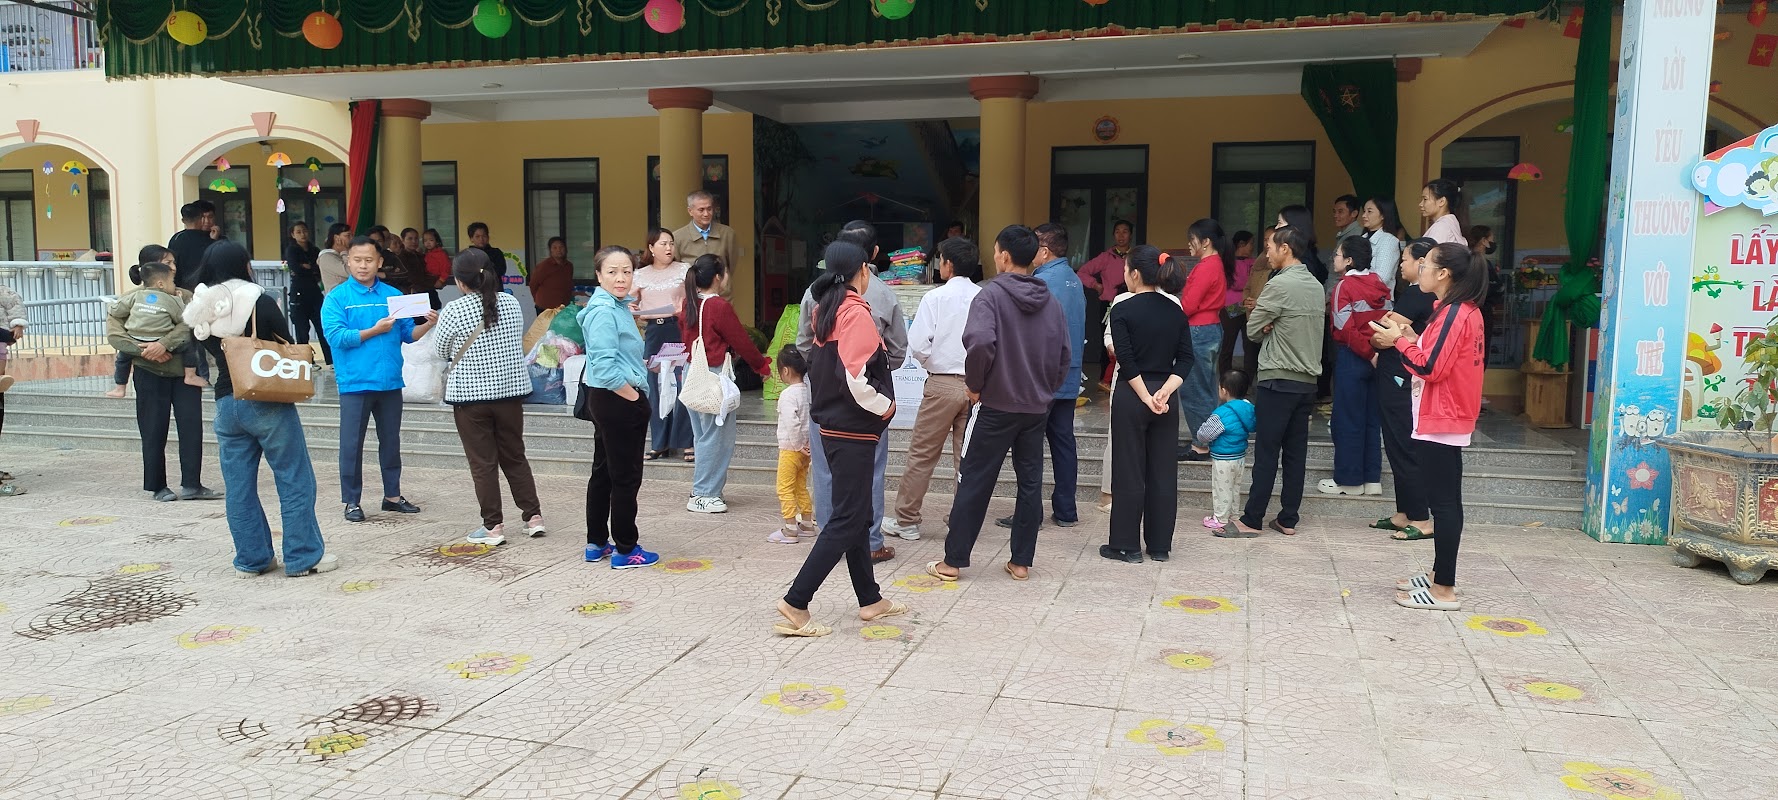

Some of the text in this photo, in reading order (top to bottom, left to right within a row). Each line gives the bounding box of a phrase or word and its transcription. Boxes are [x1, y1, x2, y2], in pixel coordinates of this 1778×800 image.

[1655, 119, 1683, 163] YÊU
[1633, 193, 1690, 236] THƯƠNG
[1644, 261, 1670, 306] VỚI
[1636, 327, 1665, 376] TRẺ
